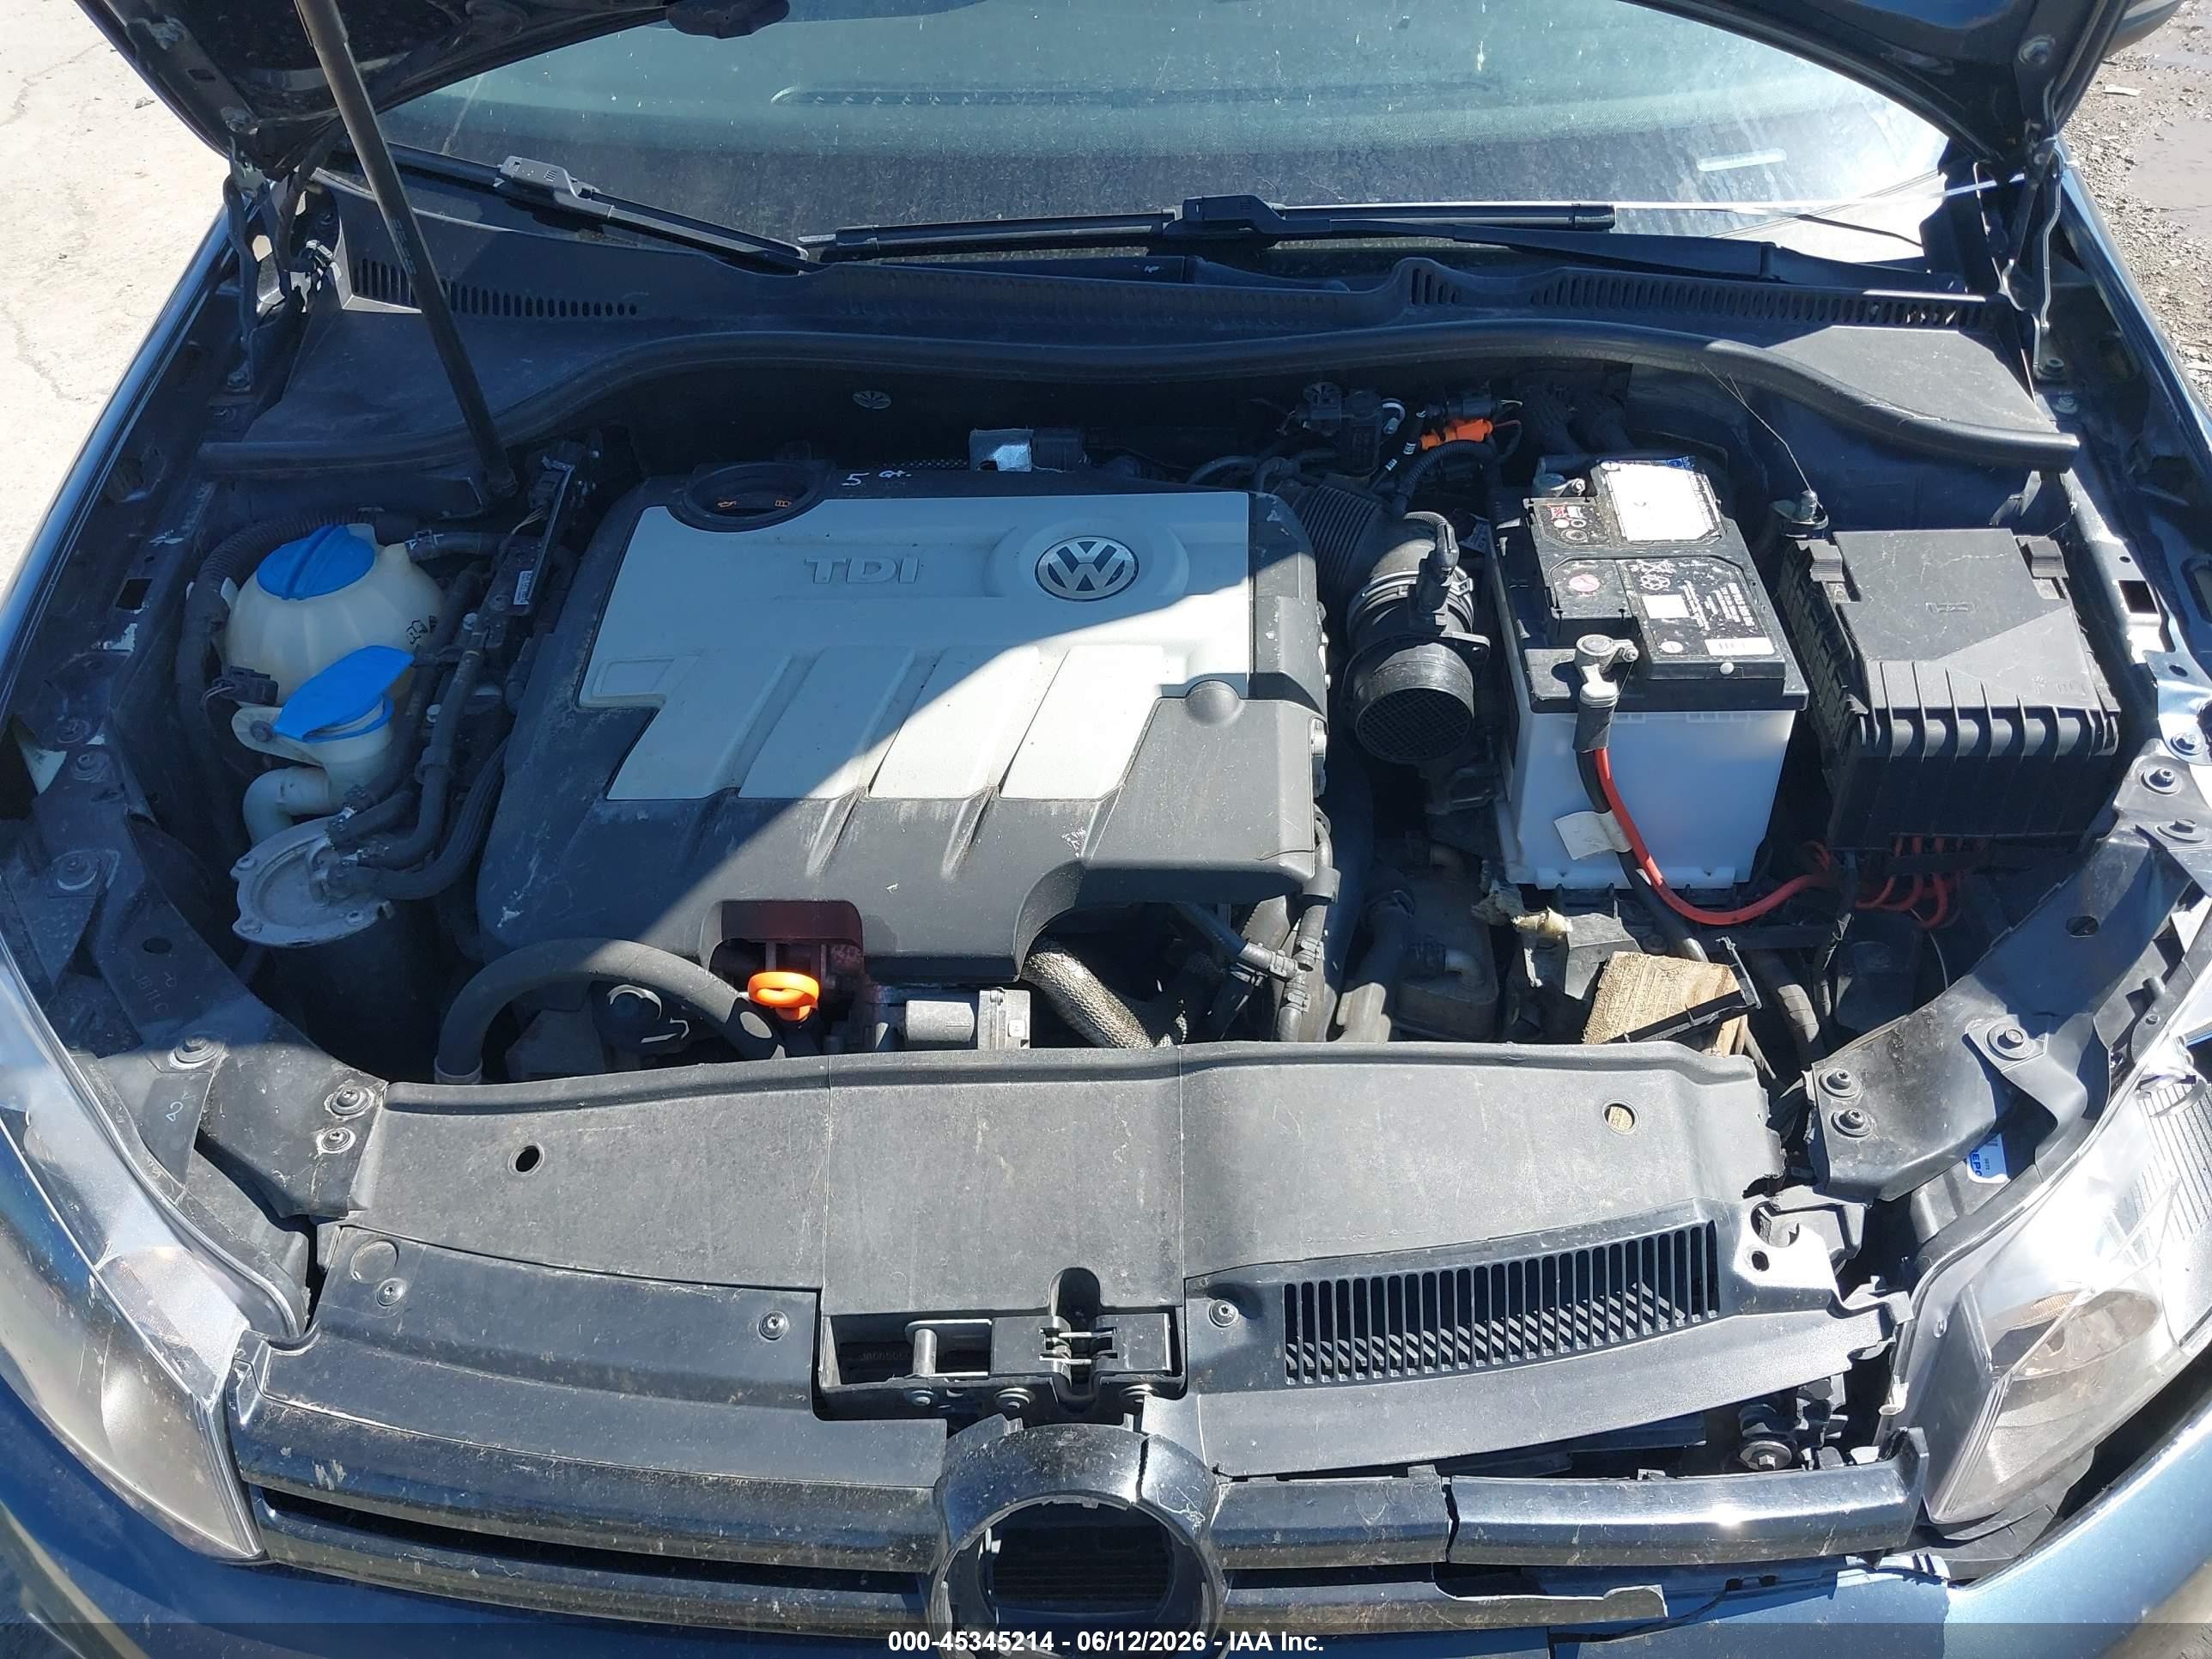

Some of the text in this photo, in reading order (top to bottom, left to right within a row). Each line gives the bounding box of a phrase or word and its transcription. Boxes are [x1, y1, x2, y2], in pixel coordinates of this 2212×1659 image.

[842, 472, 870, 486] 5
[804, 556, 920, 584] TDI
[1972, 1151, 1983, 1176] EPO
